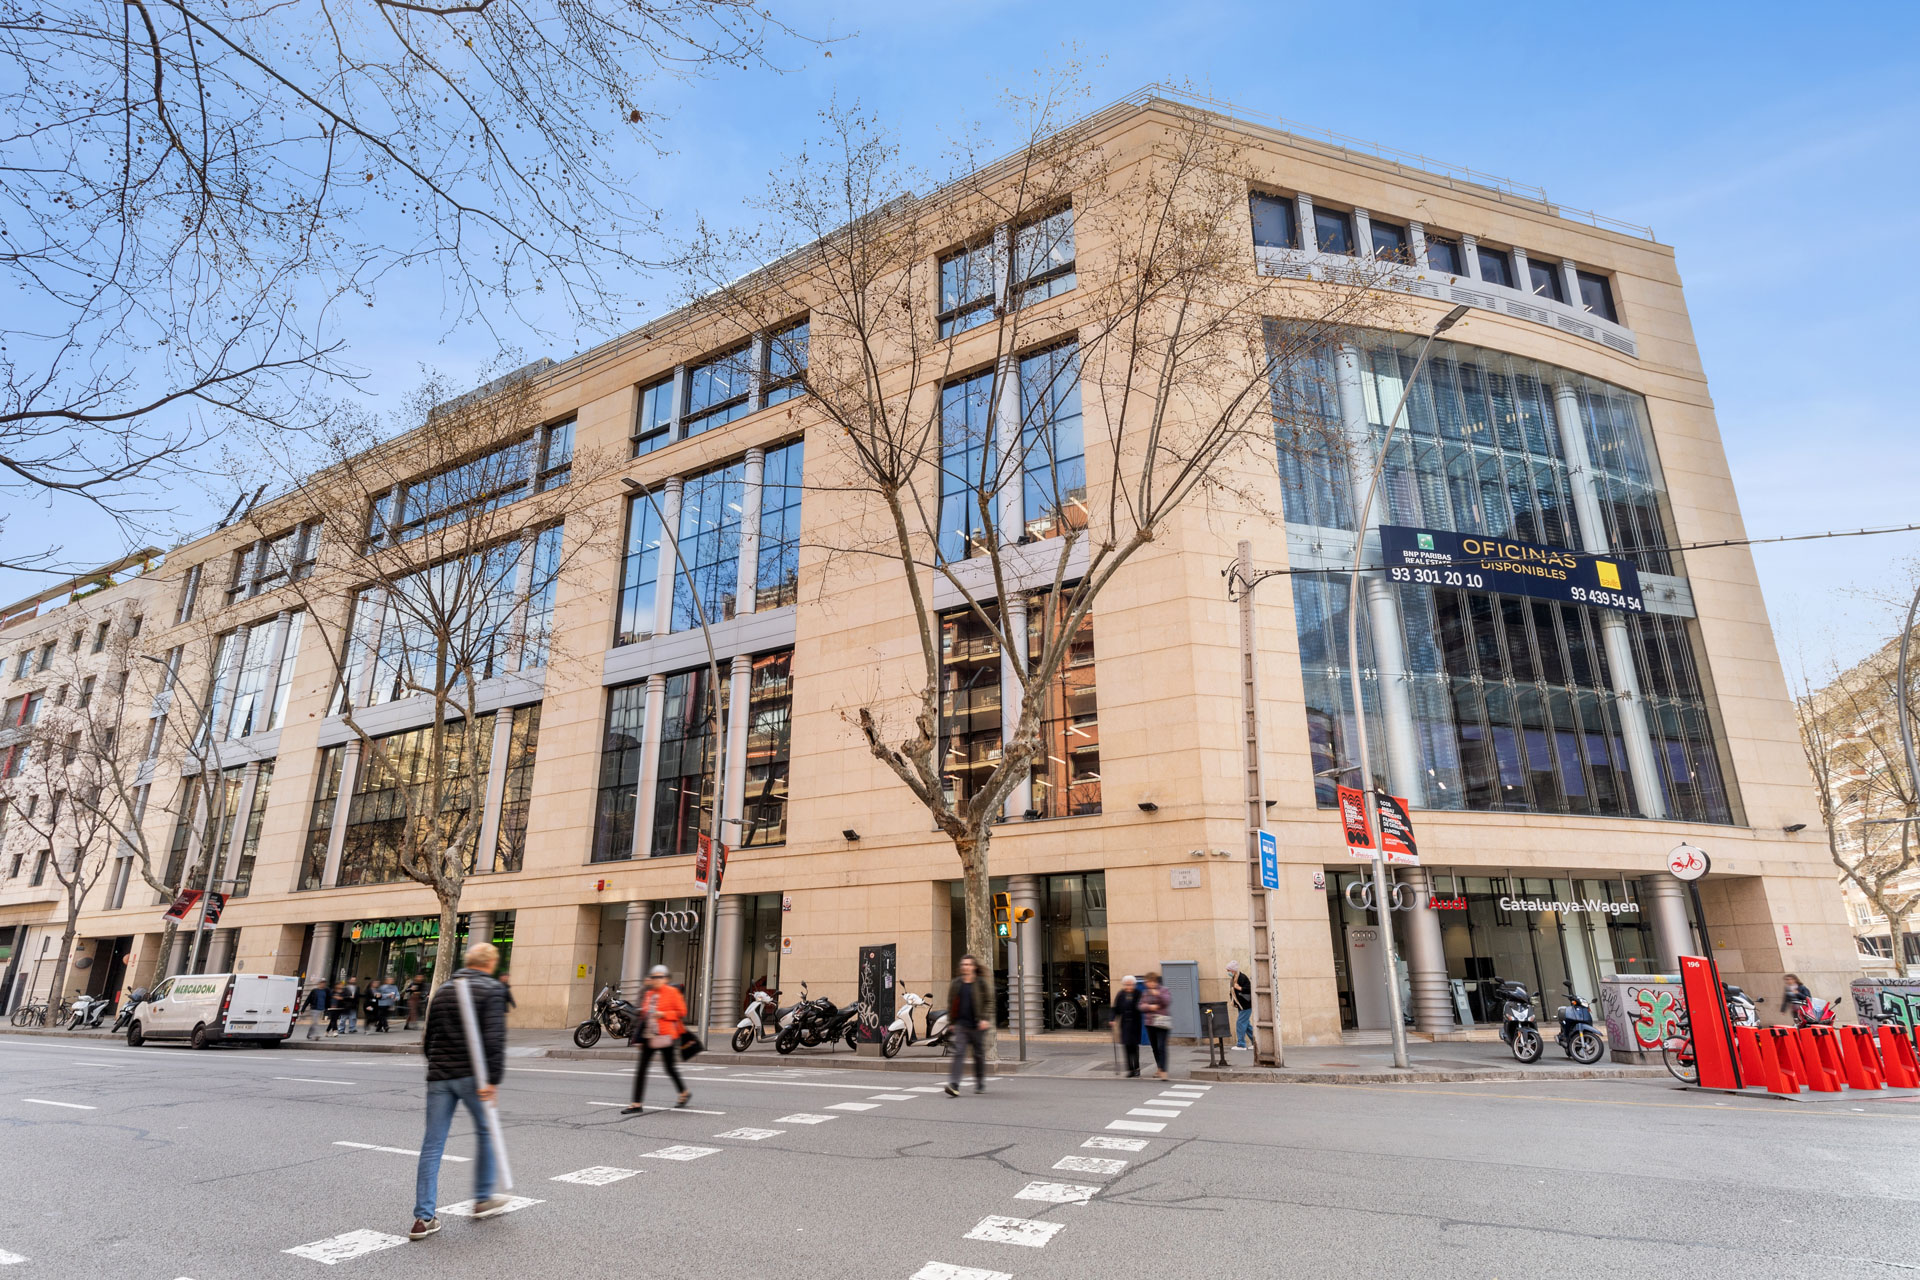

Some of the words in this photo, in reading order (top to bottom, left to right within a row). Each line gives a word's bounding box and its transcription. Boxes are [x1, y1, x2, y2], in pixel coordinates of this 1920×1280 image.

[1405, 557, 1425, 565] REAL
[1420, 552, 1452, 561] PARIBAS
[1463, 539, 1577, 569] OFICINAS
[1392, 567, 1411, 581] 93
[1414, 569, 1441, 584] 301
[1444, 571, 1462, 586] 20
[1466, 573, 1483, 588] 10
[1481, 559, 1567, 580] DISPONIBLES
[1571, 586, 1587, 601] 93
[1589, 590, 1610, 605] 439
[1611, 593, 1626, 608] 54
[1627, 597, 1642, 611] 54
[1428, 896, 1468, 911] Audi
[1500, 897, 1581, 916] Catalunya
[1582, 899, 1640, 916] Wagen
[362, 920, 440, 938] MERCADONA
[174, 984, 216, 994] MERCADONA
